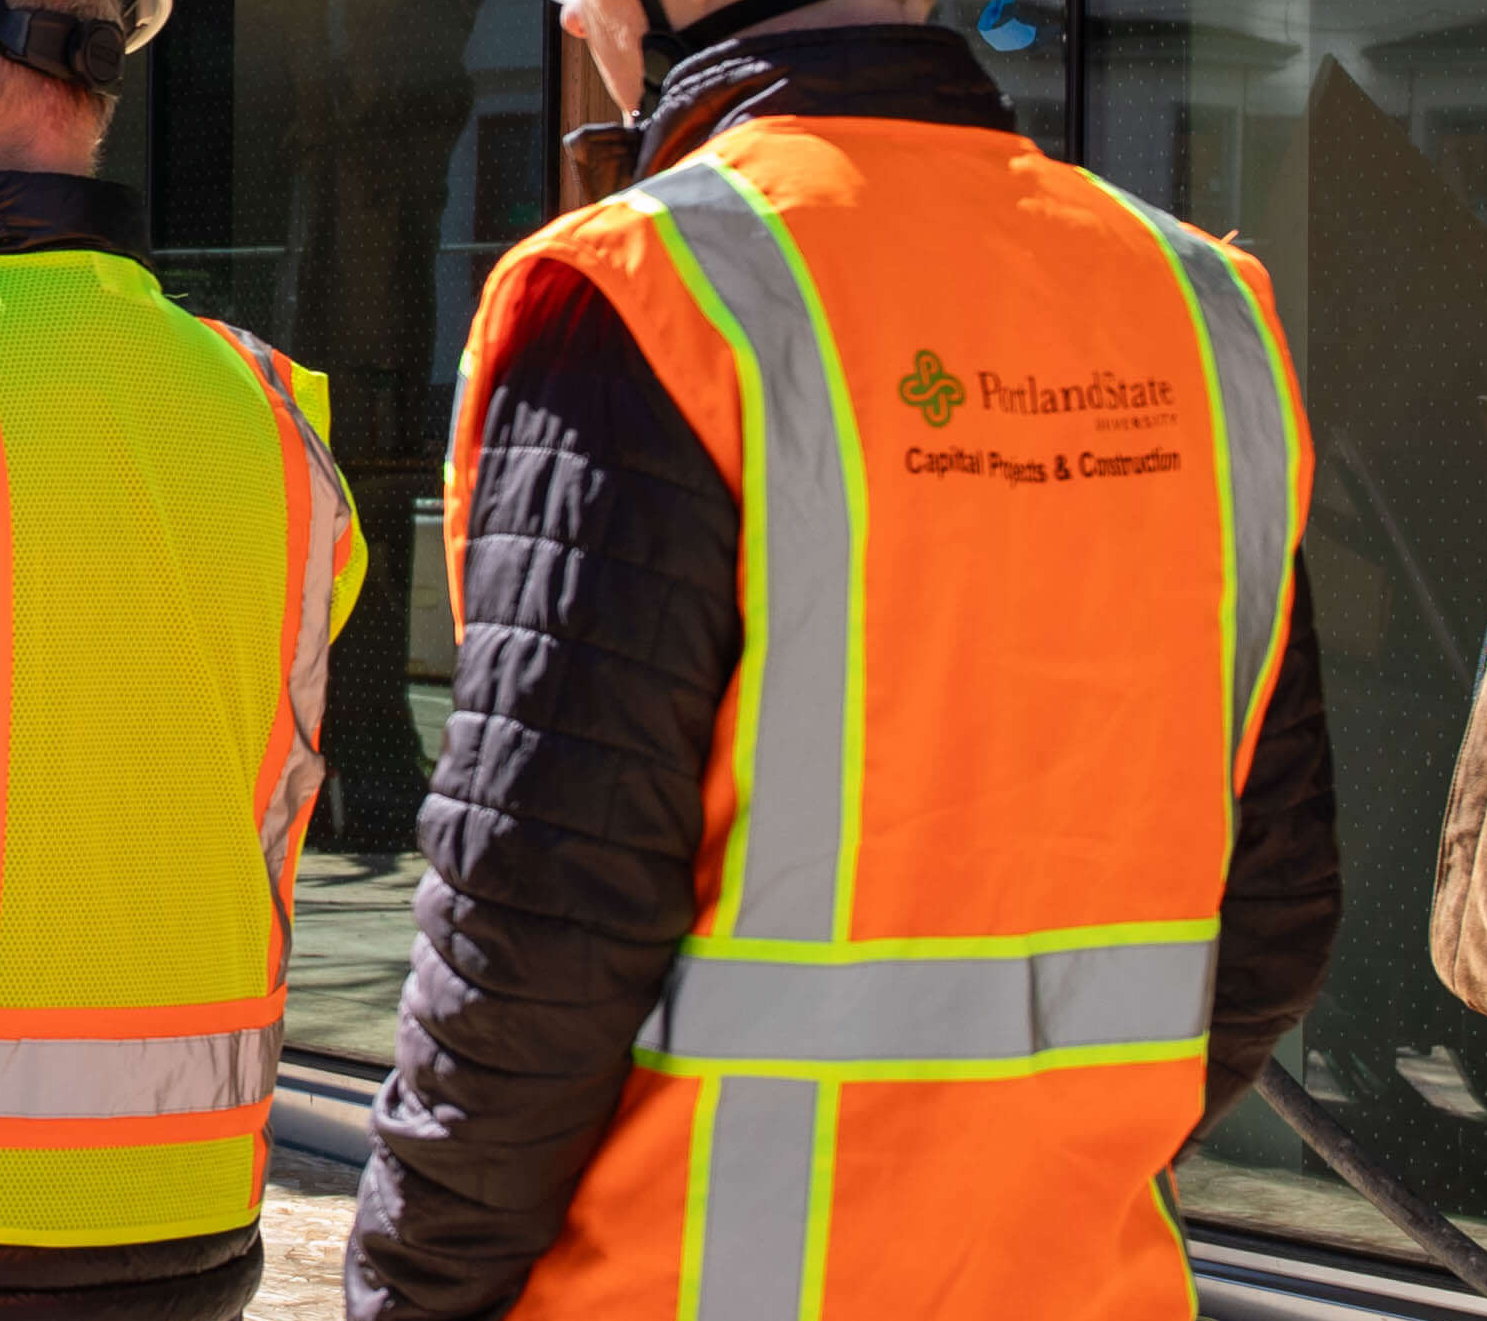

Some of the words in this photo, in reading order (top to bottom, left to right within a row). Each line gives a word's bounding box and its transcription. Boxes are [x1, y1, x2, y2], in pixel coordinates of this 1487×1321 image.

[904, 446, 983, 478] Capital
[988, 451, 1048, 488] Projects
[1053, 454, 1072, 481] &
[1078, 445, 1181, 479] Construction
